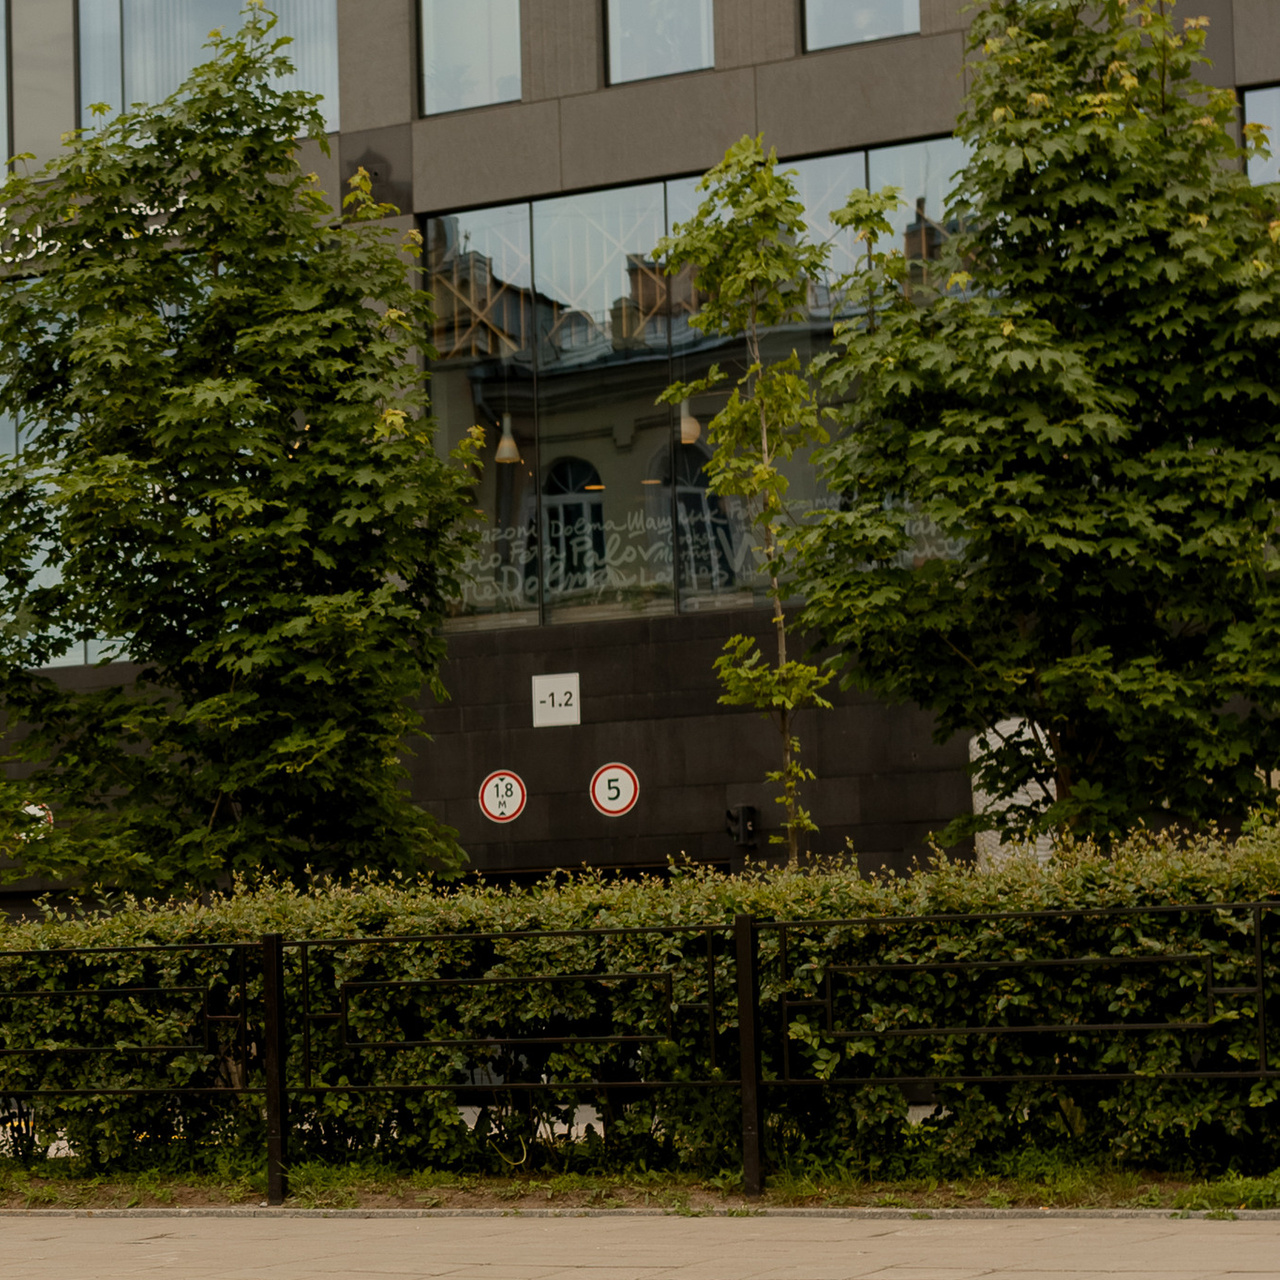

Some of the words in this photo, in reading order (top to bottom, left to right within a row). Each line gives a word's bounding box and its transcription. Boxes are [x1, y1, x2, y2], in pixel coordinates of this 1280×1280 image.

[540, 691, 573, 708] -1.2
[494, 783, 514, 799] 1,8
[607, 779, 621, 801] 5
